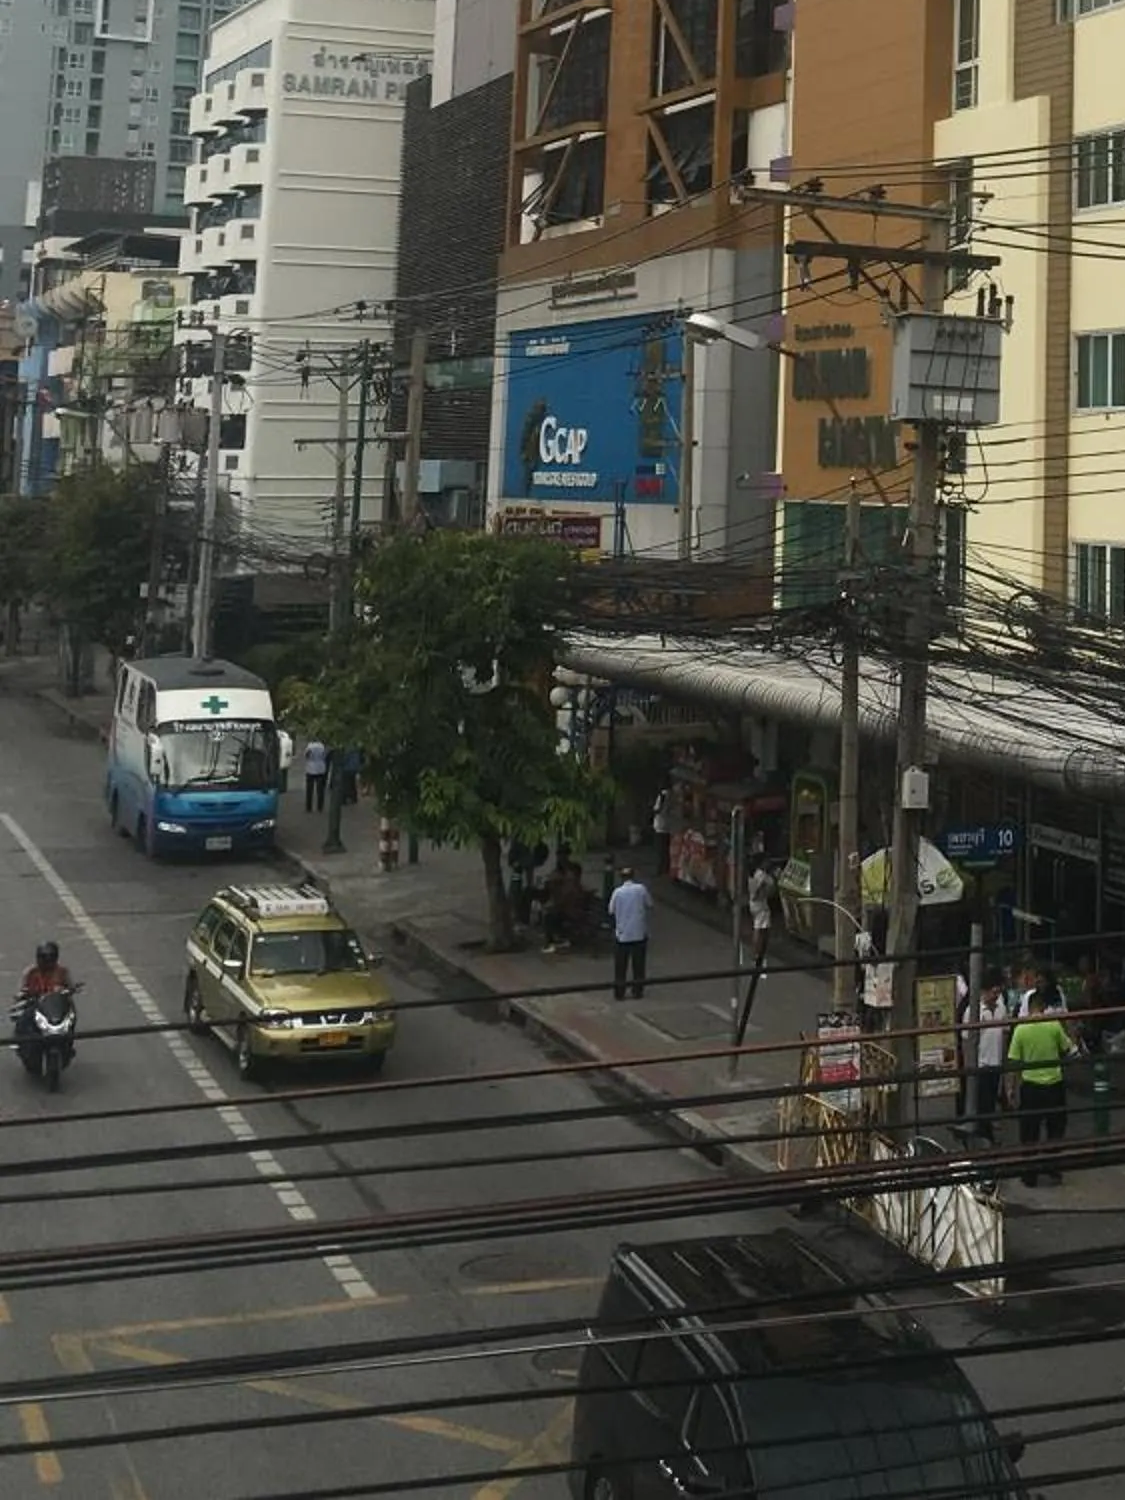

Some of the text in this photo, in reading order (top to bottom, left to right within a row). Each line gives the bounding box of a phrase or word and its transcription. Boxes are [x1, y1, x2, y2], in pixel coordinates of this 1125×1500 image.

[282, 72, 377, 98] SAMRAN
[539, 415, 588, 465] GCAP
[998, 828, 1013, 847] 10
